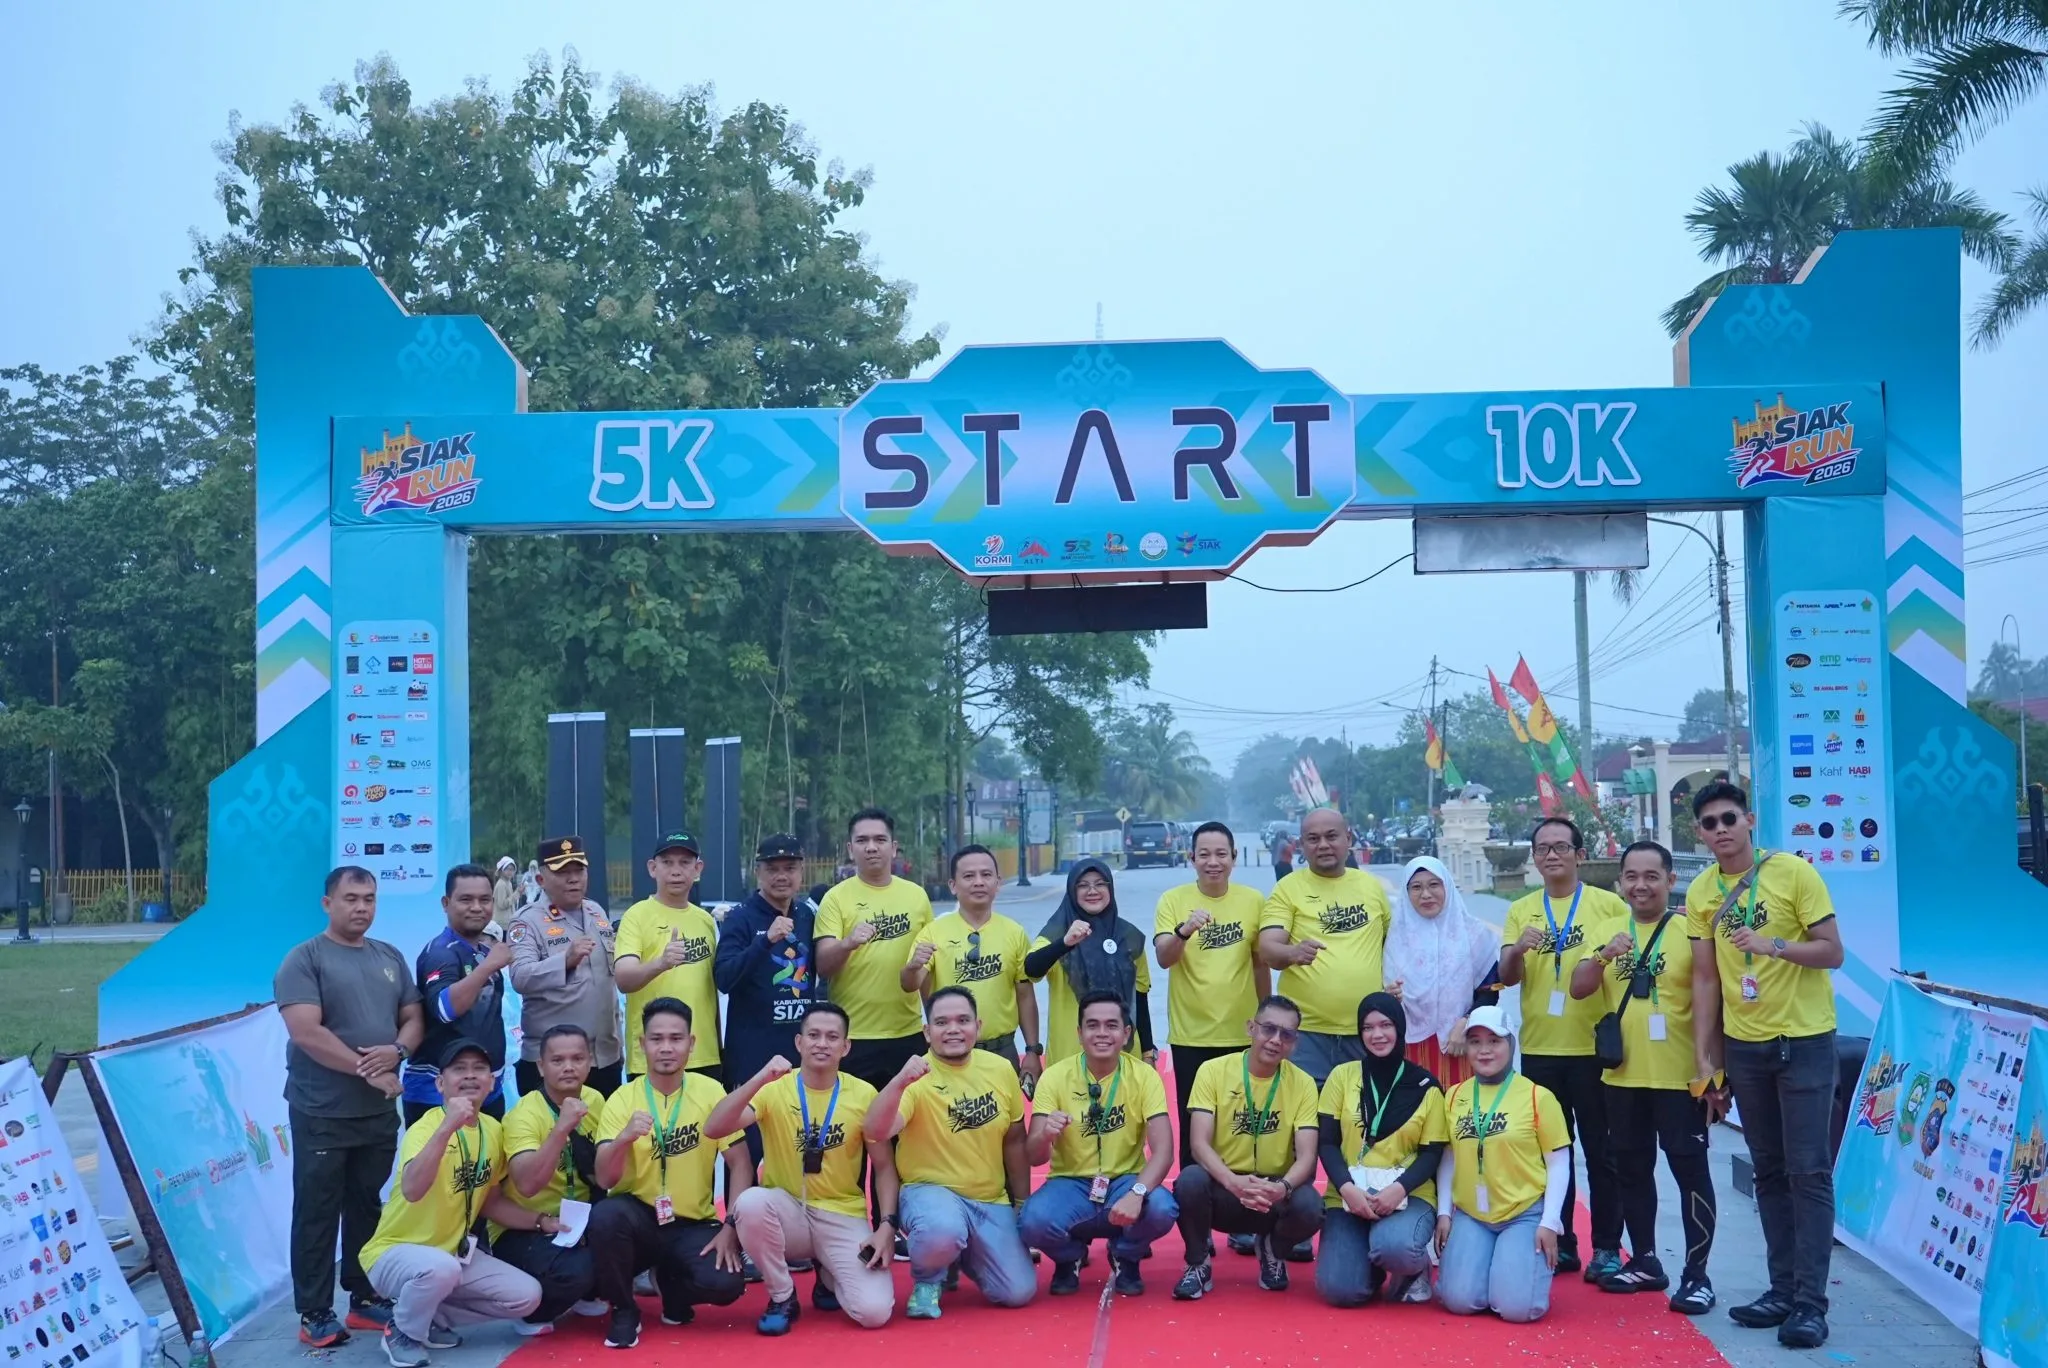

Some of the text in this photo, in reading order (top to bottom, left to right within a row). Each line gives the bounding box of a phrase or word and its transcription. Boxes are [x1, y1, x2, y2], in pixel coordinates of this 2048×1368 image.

[1774, 401, 1851, 445] SIAK
[399, 432, 475, 475] SIAK
[1486, 402, 1641, 488] 10K
[1784, 424, 1854, 471] RUN
[863, 404, 1330, 508] START
[590, 419, 715, 511] 5K
[1814, 462, 1851, 481] 2026
[408, 455, 475, 500] RUN
[436, 491, 472, 510] 2026
[1198, 541, 1221, 549] SIAK
[975, 555, 1012, 566] KORMI
[1820, 766, 1843, 776] Kahf
[1849, 766, 1871, 775] HABI
[1336, 903, 1365, 919] SIAK
[1343, 912, 1369, 927] RUN
[881, 912, 909, 928] SIAK
[885, 920, 911, 937] RUN
[1214, 920, 1242, 936] SIAK
[548, 936, 571, 947] PURBA
[1217, 929, 1244, 945] RUN
[975, 962, 1003, 979] RUN
[773, 1005, 805, 1021] SIA
[965, 1091, 994, 1114] SIAK
[973, 1101, 998, 1125] RUN
[670, 1132, 700, 1153] RUN
